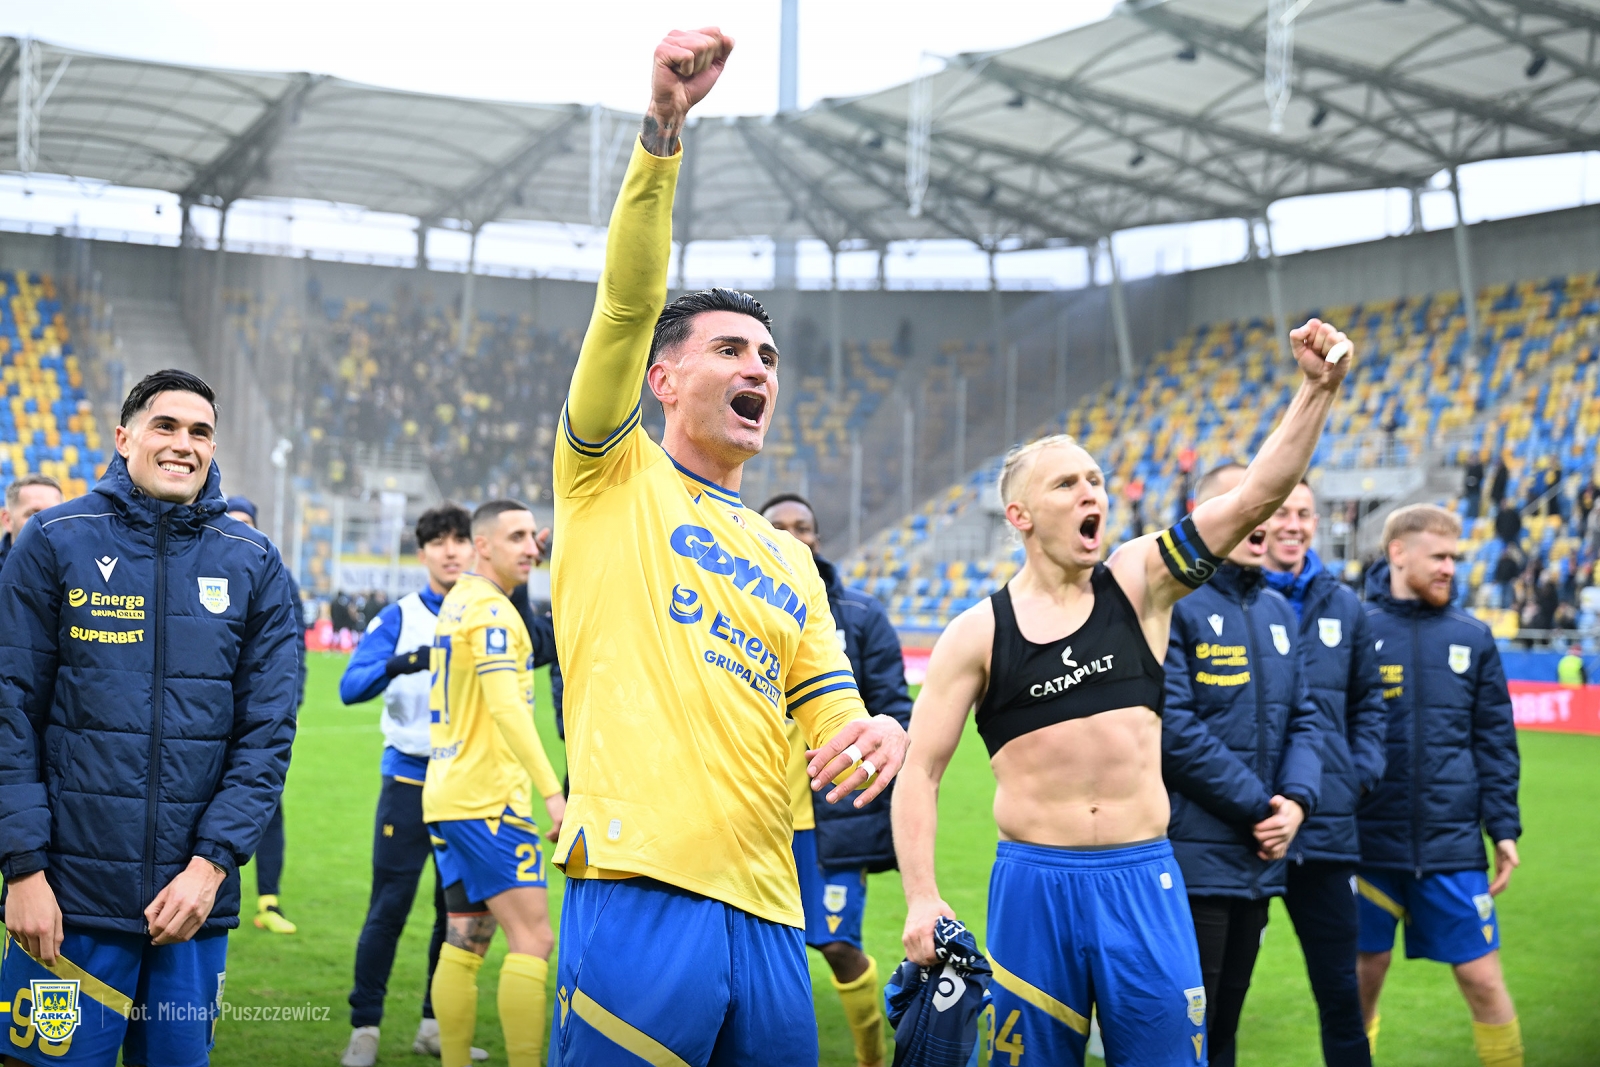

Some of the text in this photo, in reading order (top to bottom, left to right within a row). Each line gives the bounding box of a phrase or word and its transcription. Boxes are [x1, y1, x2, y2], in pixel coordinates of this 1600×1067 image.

[670, 524, 807, 633] GDYNIA
[91, 592, 145, 610] Energa
[91, 609, 117, 618] GRUPA
[70, 626, 145, 644] SUPERBET
[709, 610, 781, 681] Energ
[704, 650, 752, 682] GRUPA
[1030, 654, 1114, 697] CATAPULT
